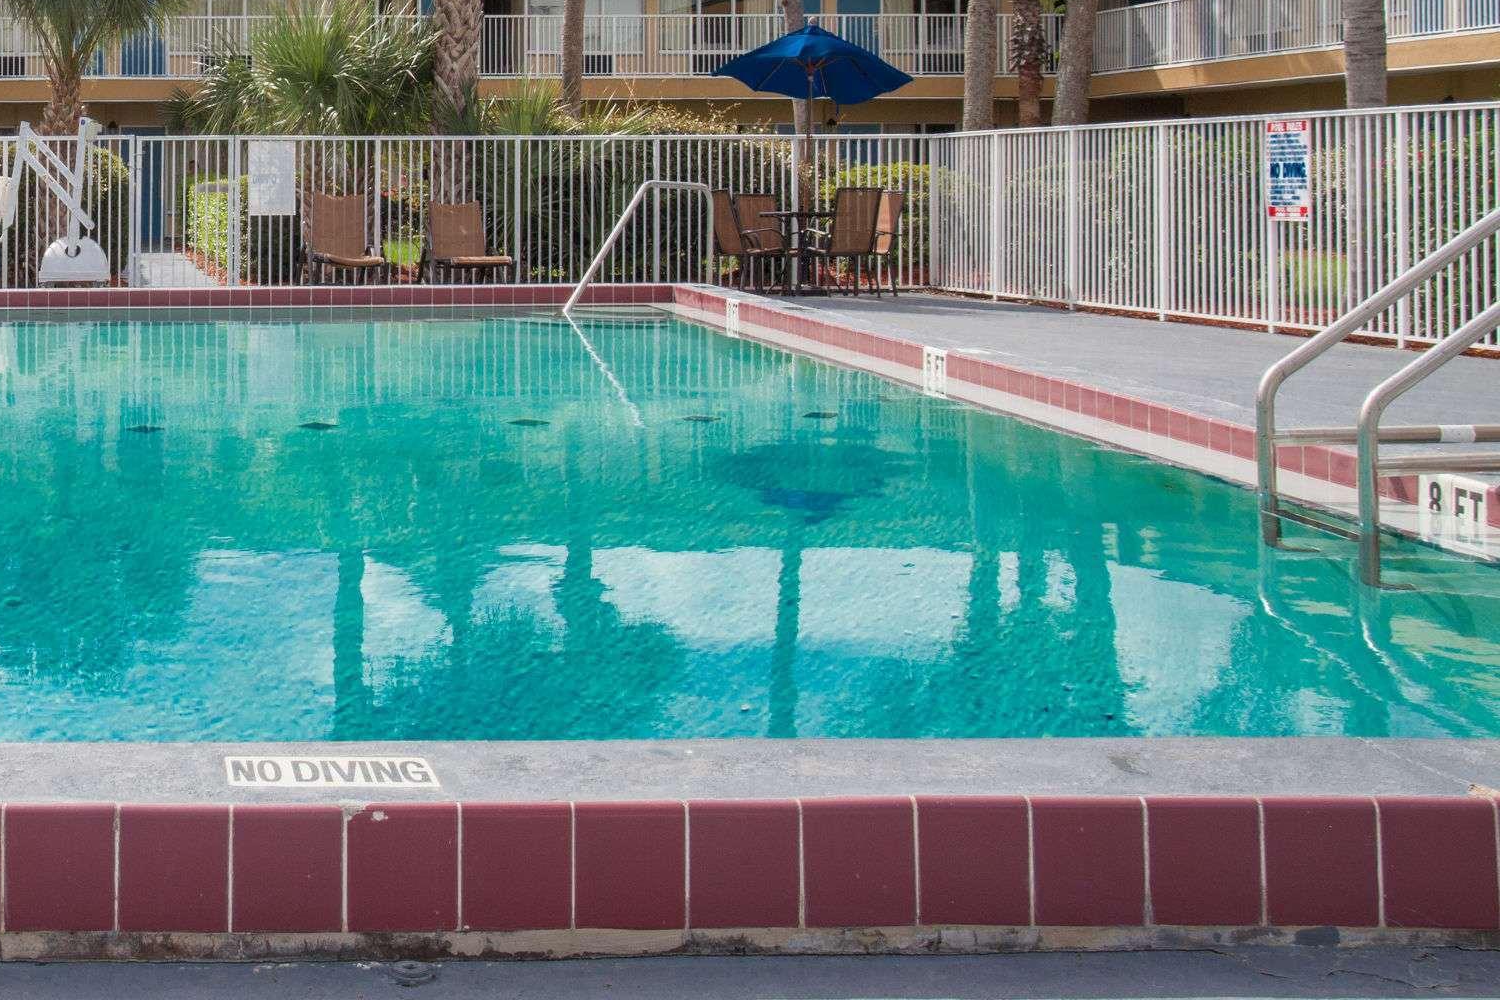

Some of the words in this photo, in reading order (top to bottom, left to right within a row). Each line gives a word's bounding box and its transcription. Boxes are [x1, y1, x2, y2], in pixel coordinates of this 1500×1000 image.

[1270, 162, 1280, 178] NO
[1429, 481, 1442, 512] 8
[1455, 486, 1483, 522] FT
[230, 759, 282, 783] NO
[291, 759, 433, 783] DIVING
